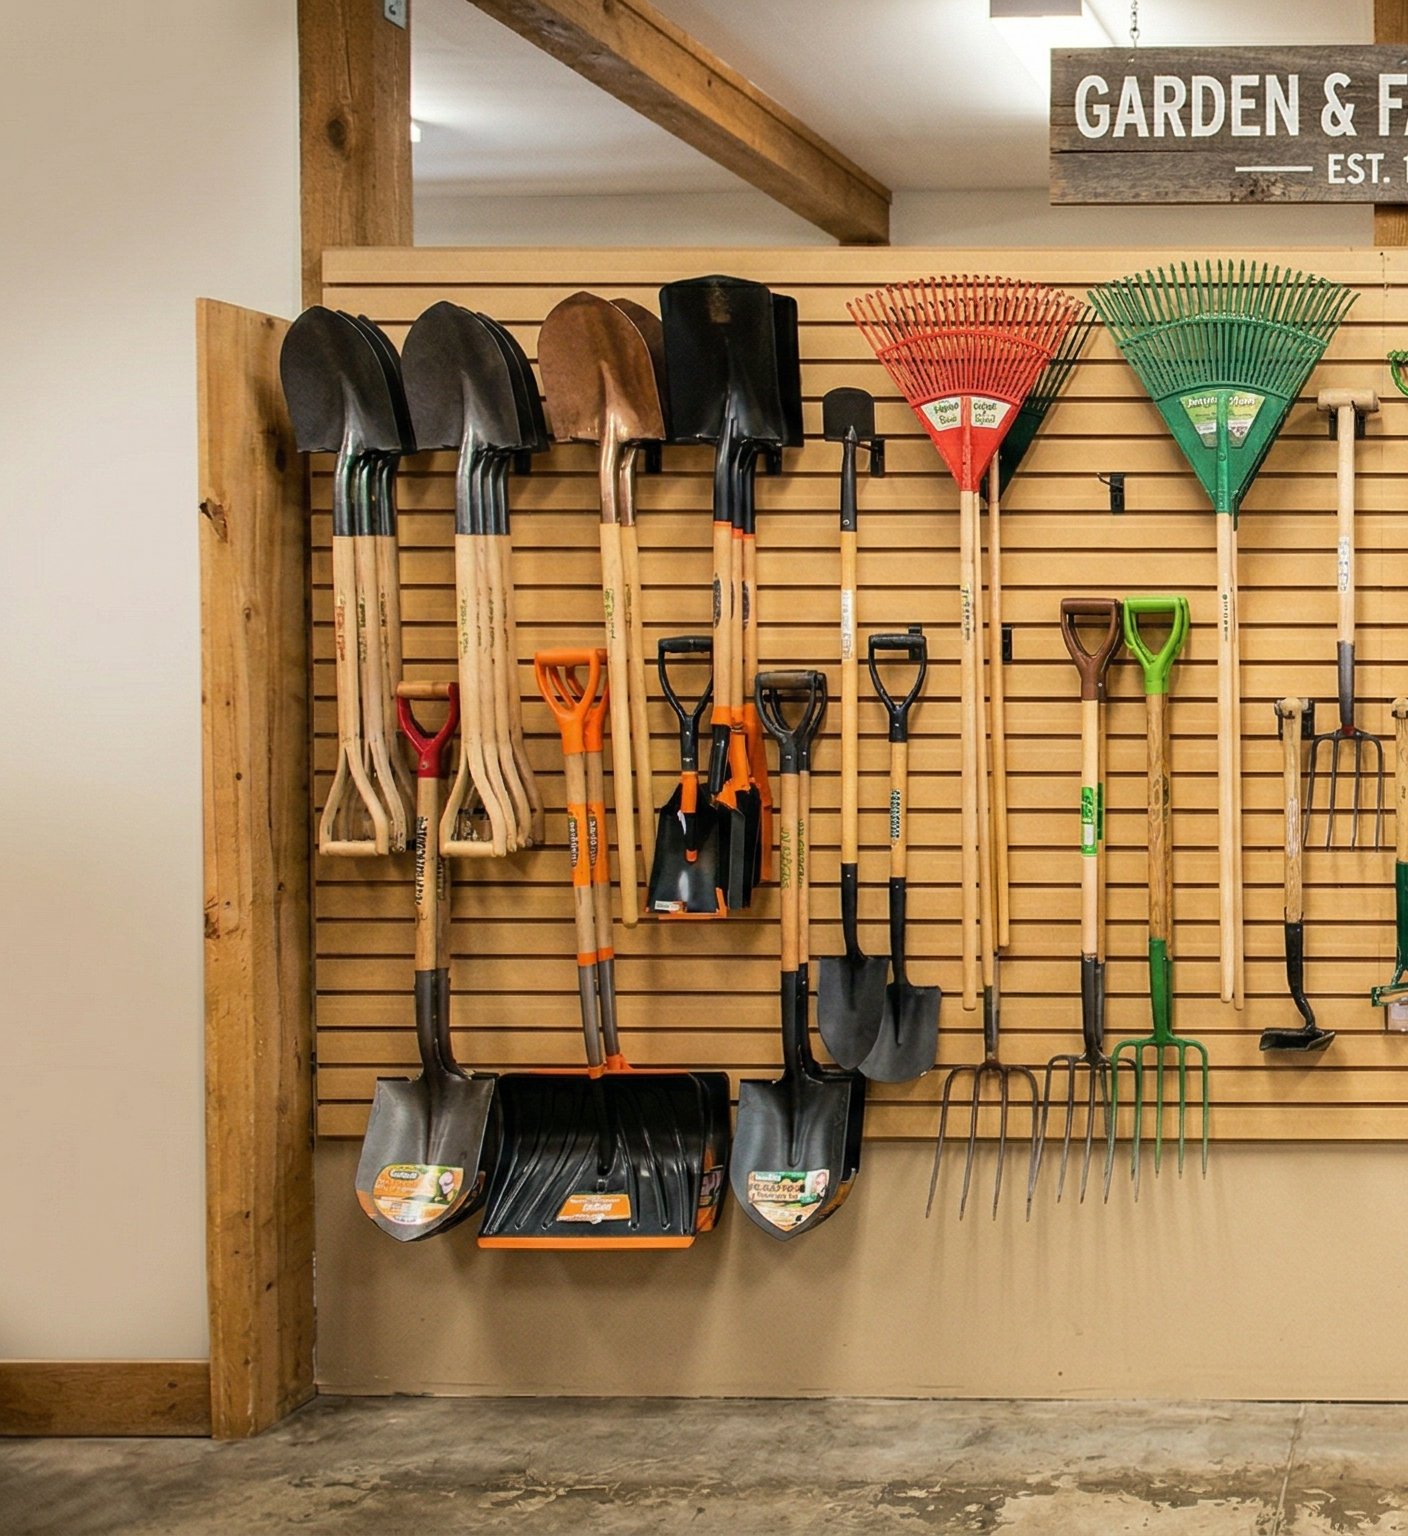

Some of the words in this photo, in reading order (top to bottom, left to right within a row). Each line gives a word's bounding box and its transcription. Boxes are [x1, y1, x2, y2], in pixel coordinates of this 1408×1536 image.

[1074, 74, 1300, 138] GARDEN
[1321, 72, 1358, 137] &
[1327, 152, 1391, 185] EST.
